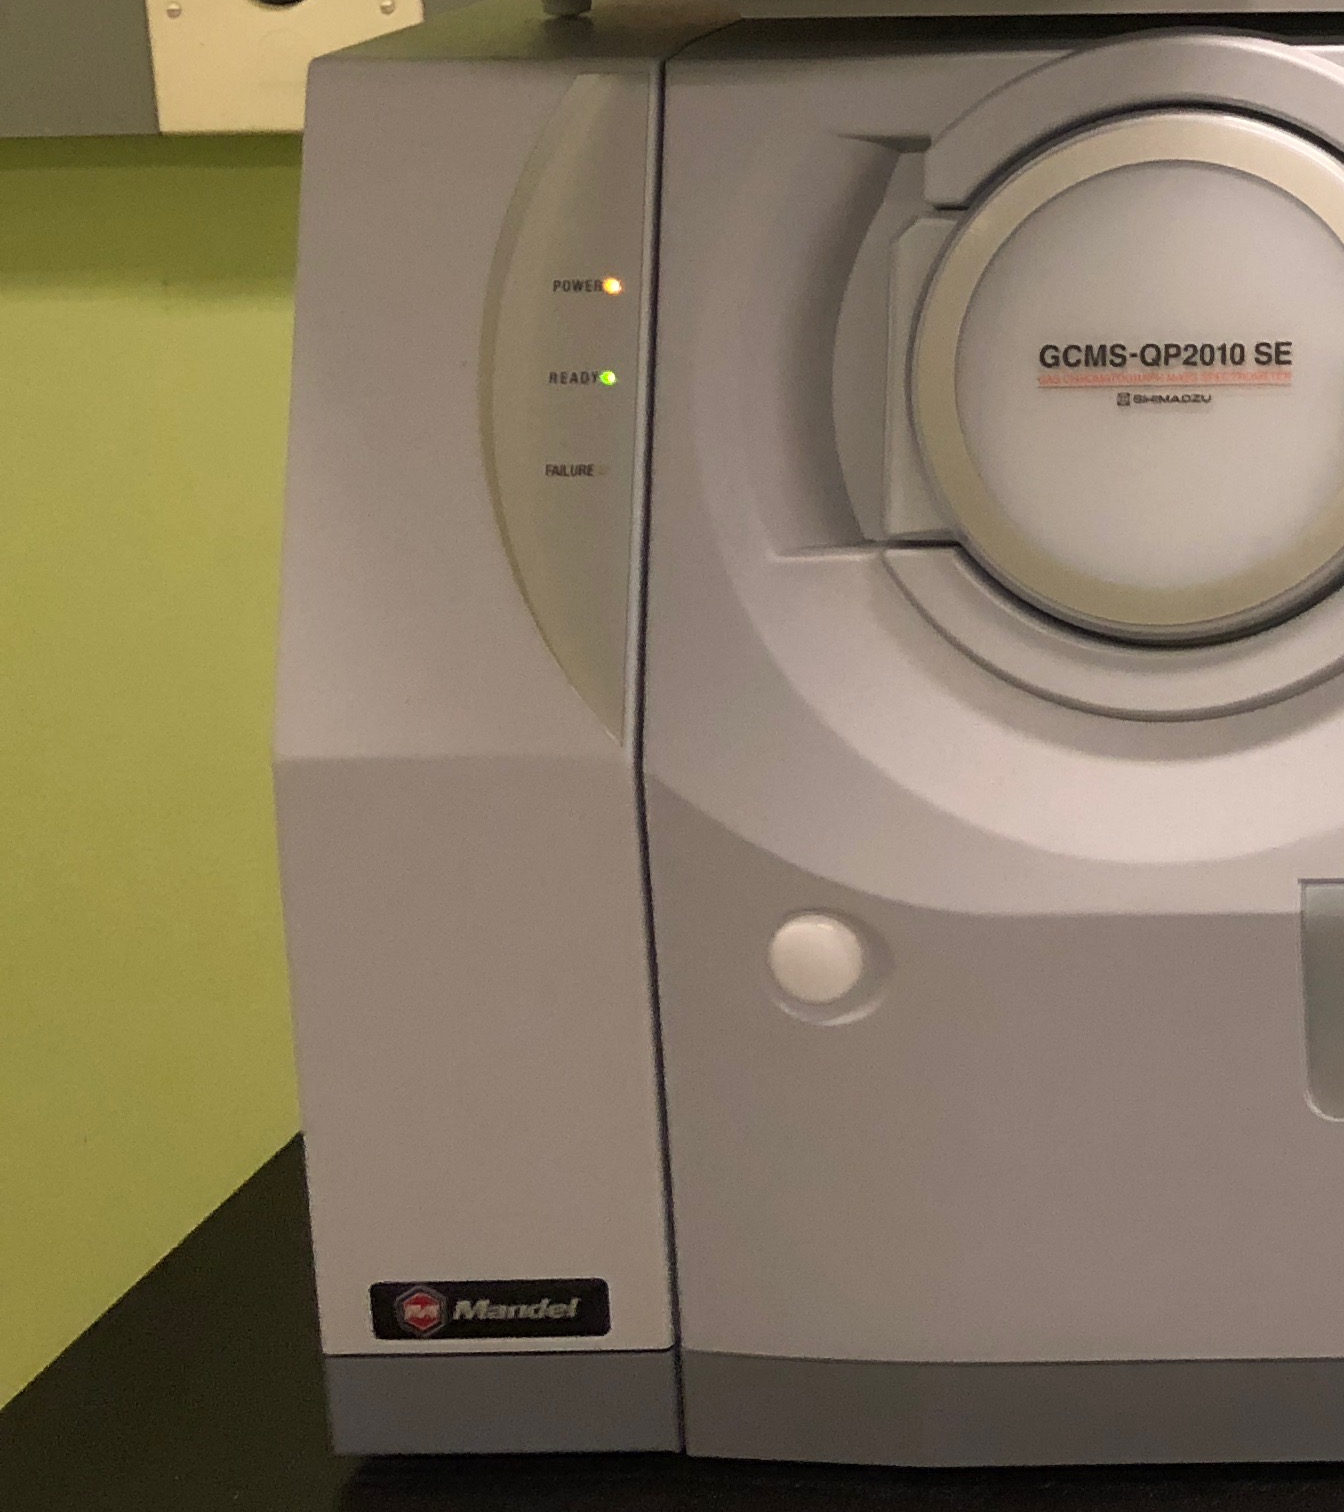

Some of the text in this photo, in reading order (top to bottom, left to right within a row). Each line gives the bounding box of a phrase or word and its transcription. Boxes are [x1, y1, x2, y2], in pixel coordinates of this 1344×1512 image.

[553, 279, 604, 292] POWER
[1039, 341, 1293, 368] GCMS-QP2010 SE
[549, 370, 600, 385] READY
[1133, 393, 1212, 404] SHIMADZU
[545, 463, 595, 478] FAILURE
[452, 1297, 581, 1321] Mandel
